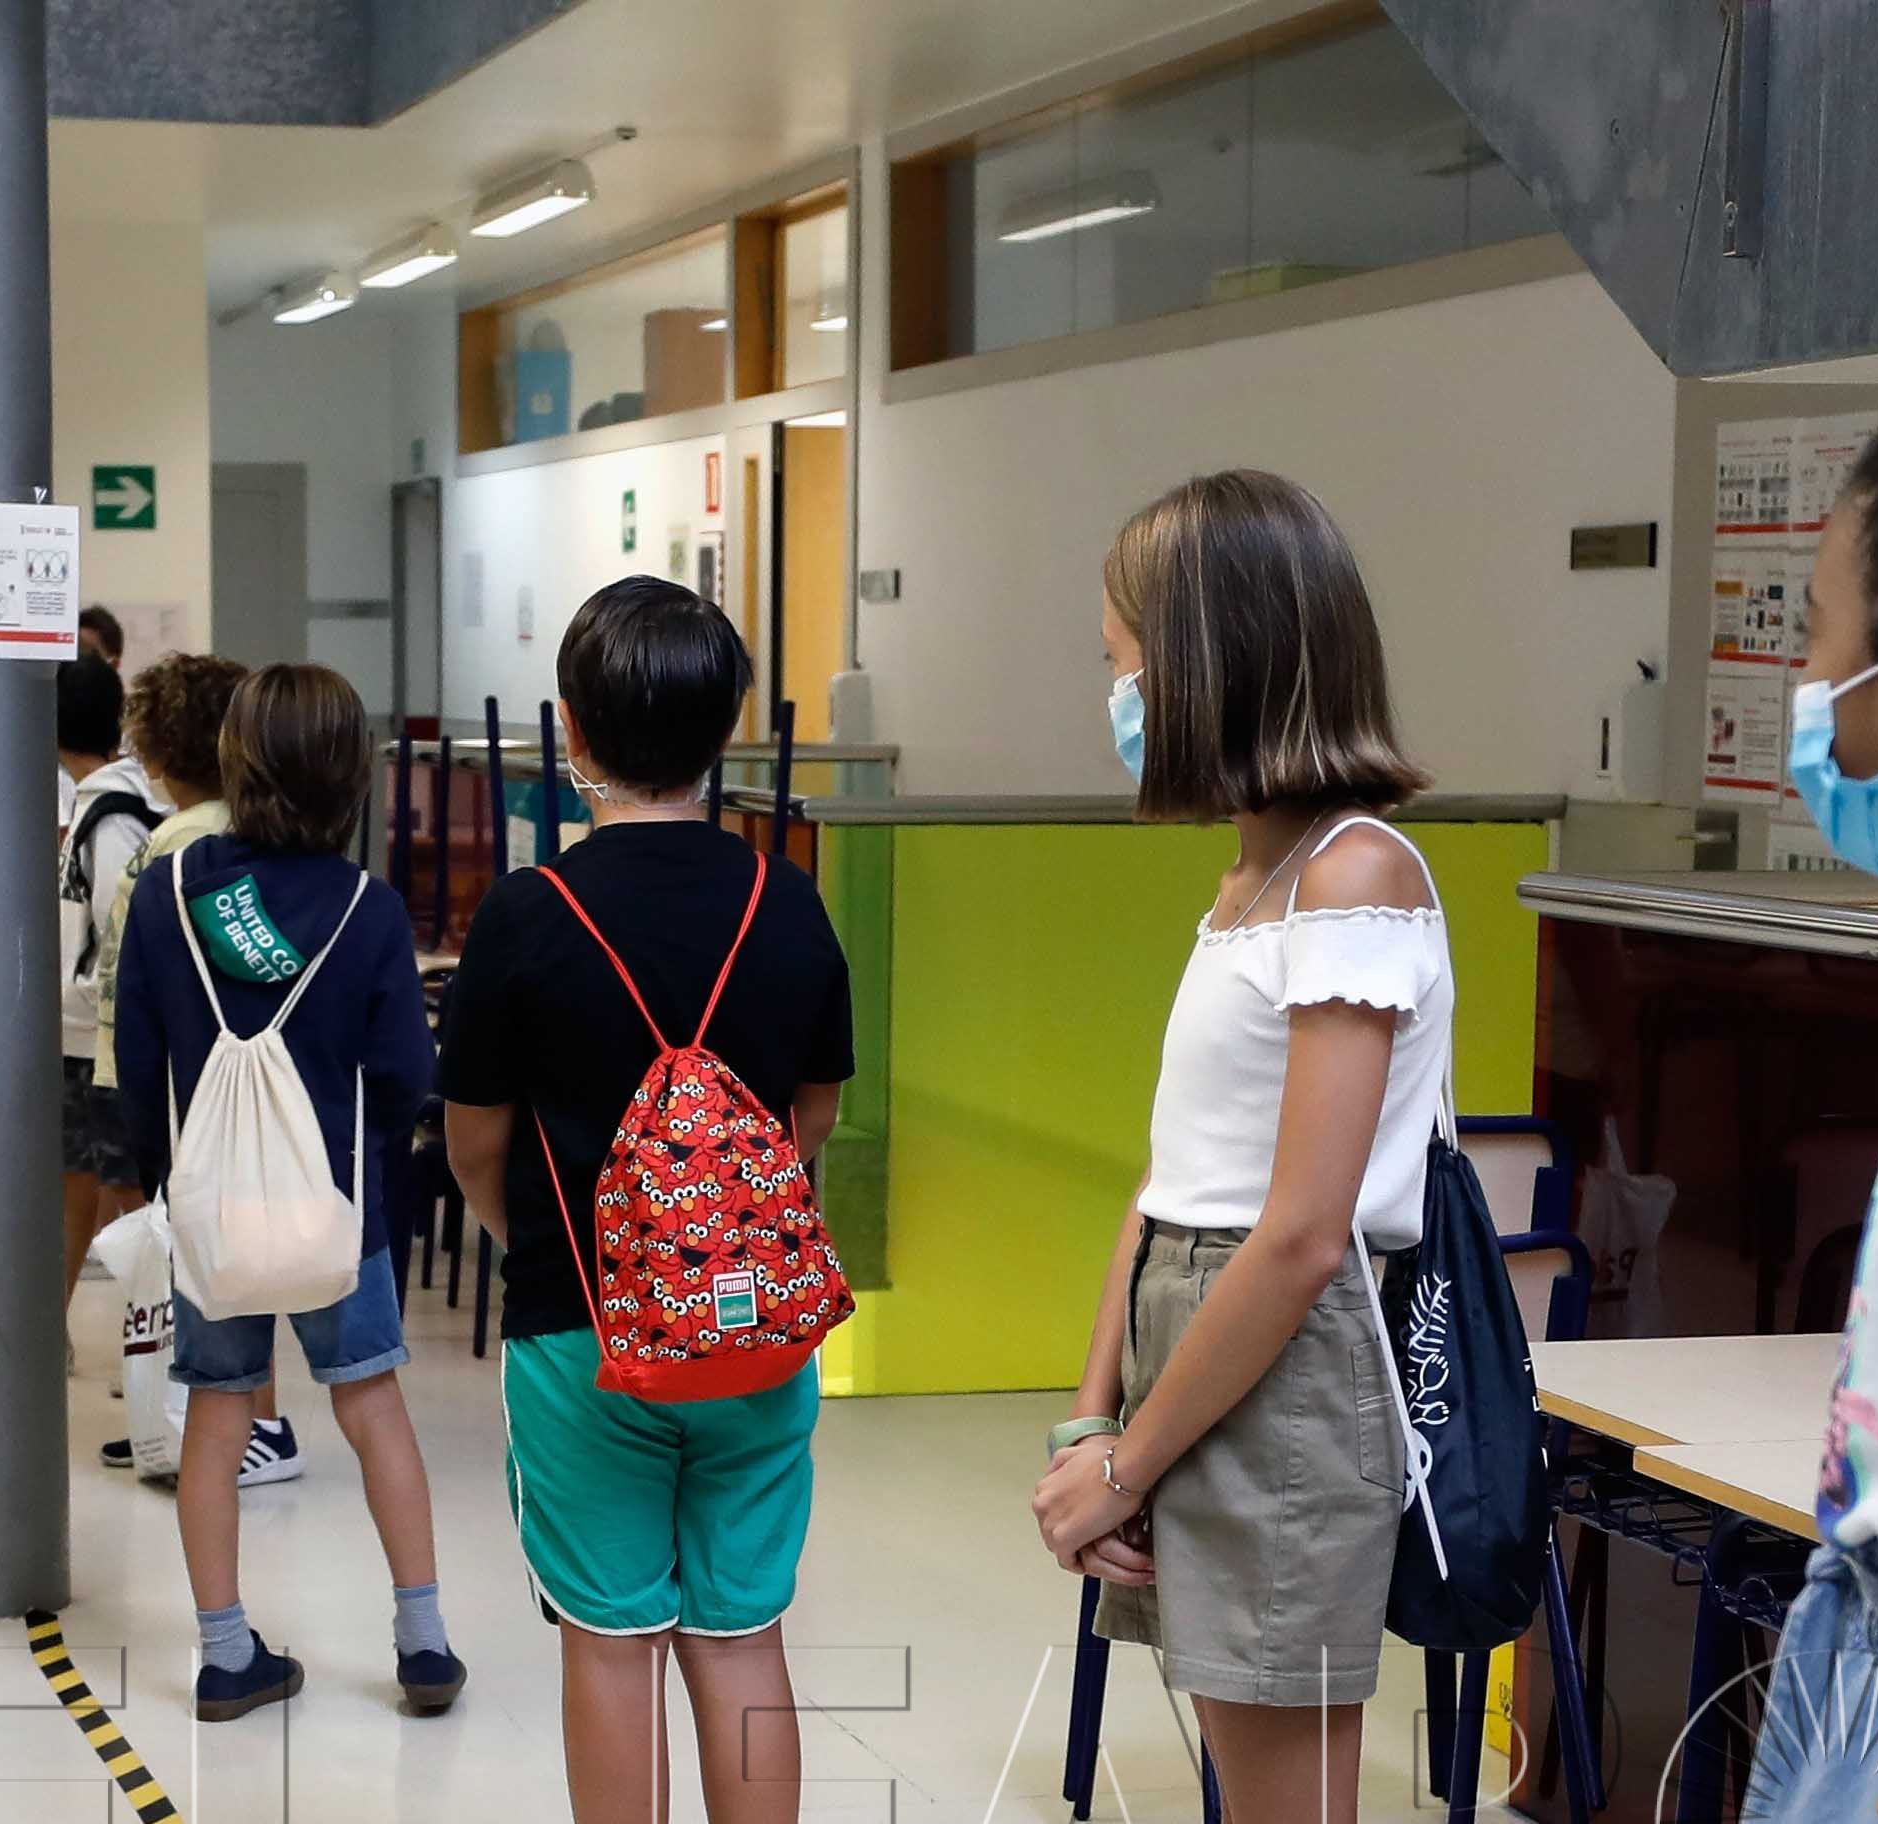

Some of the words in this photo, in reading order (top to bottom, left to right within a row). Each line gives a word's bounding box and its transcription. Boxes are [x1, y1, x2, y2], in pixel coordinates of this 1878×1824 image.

[215, 894, 237, 921] OF
[235, 883, 275, 949] UNITED
[718, 1277, 750, 1294] PUMA
